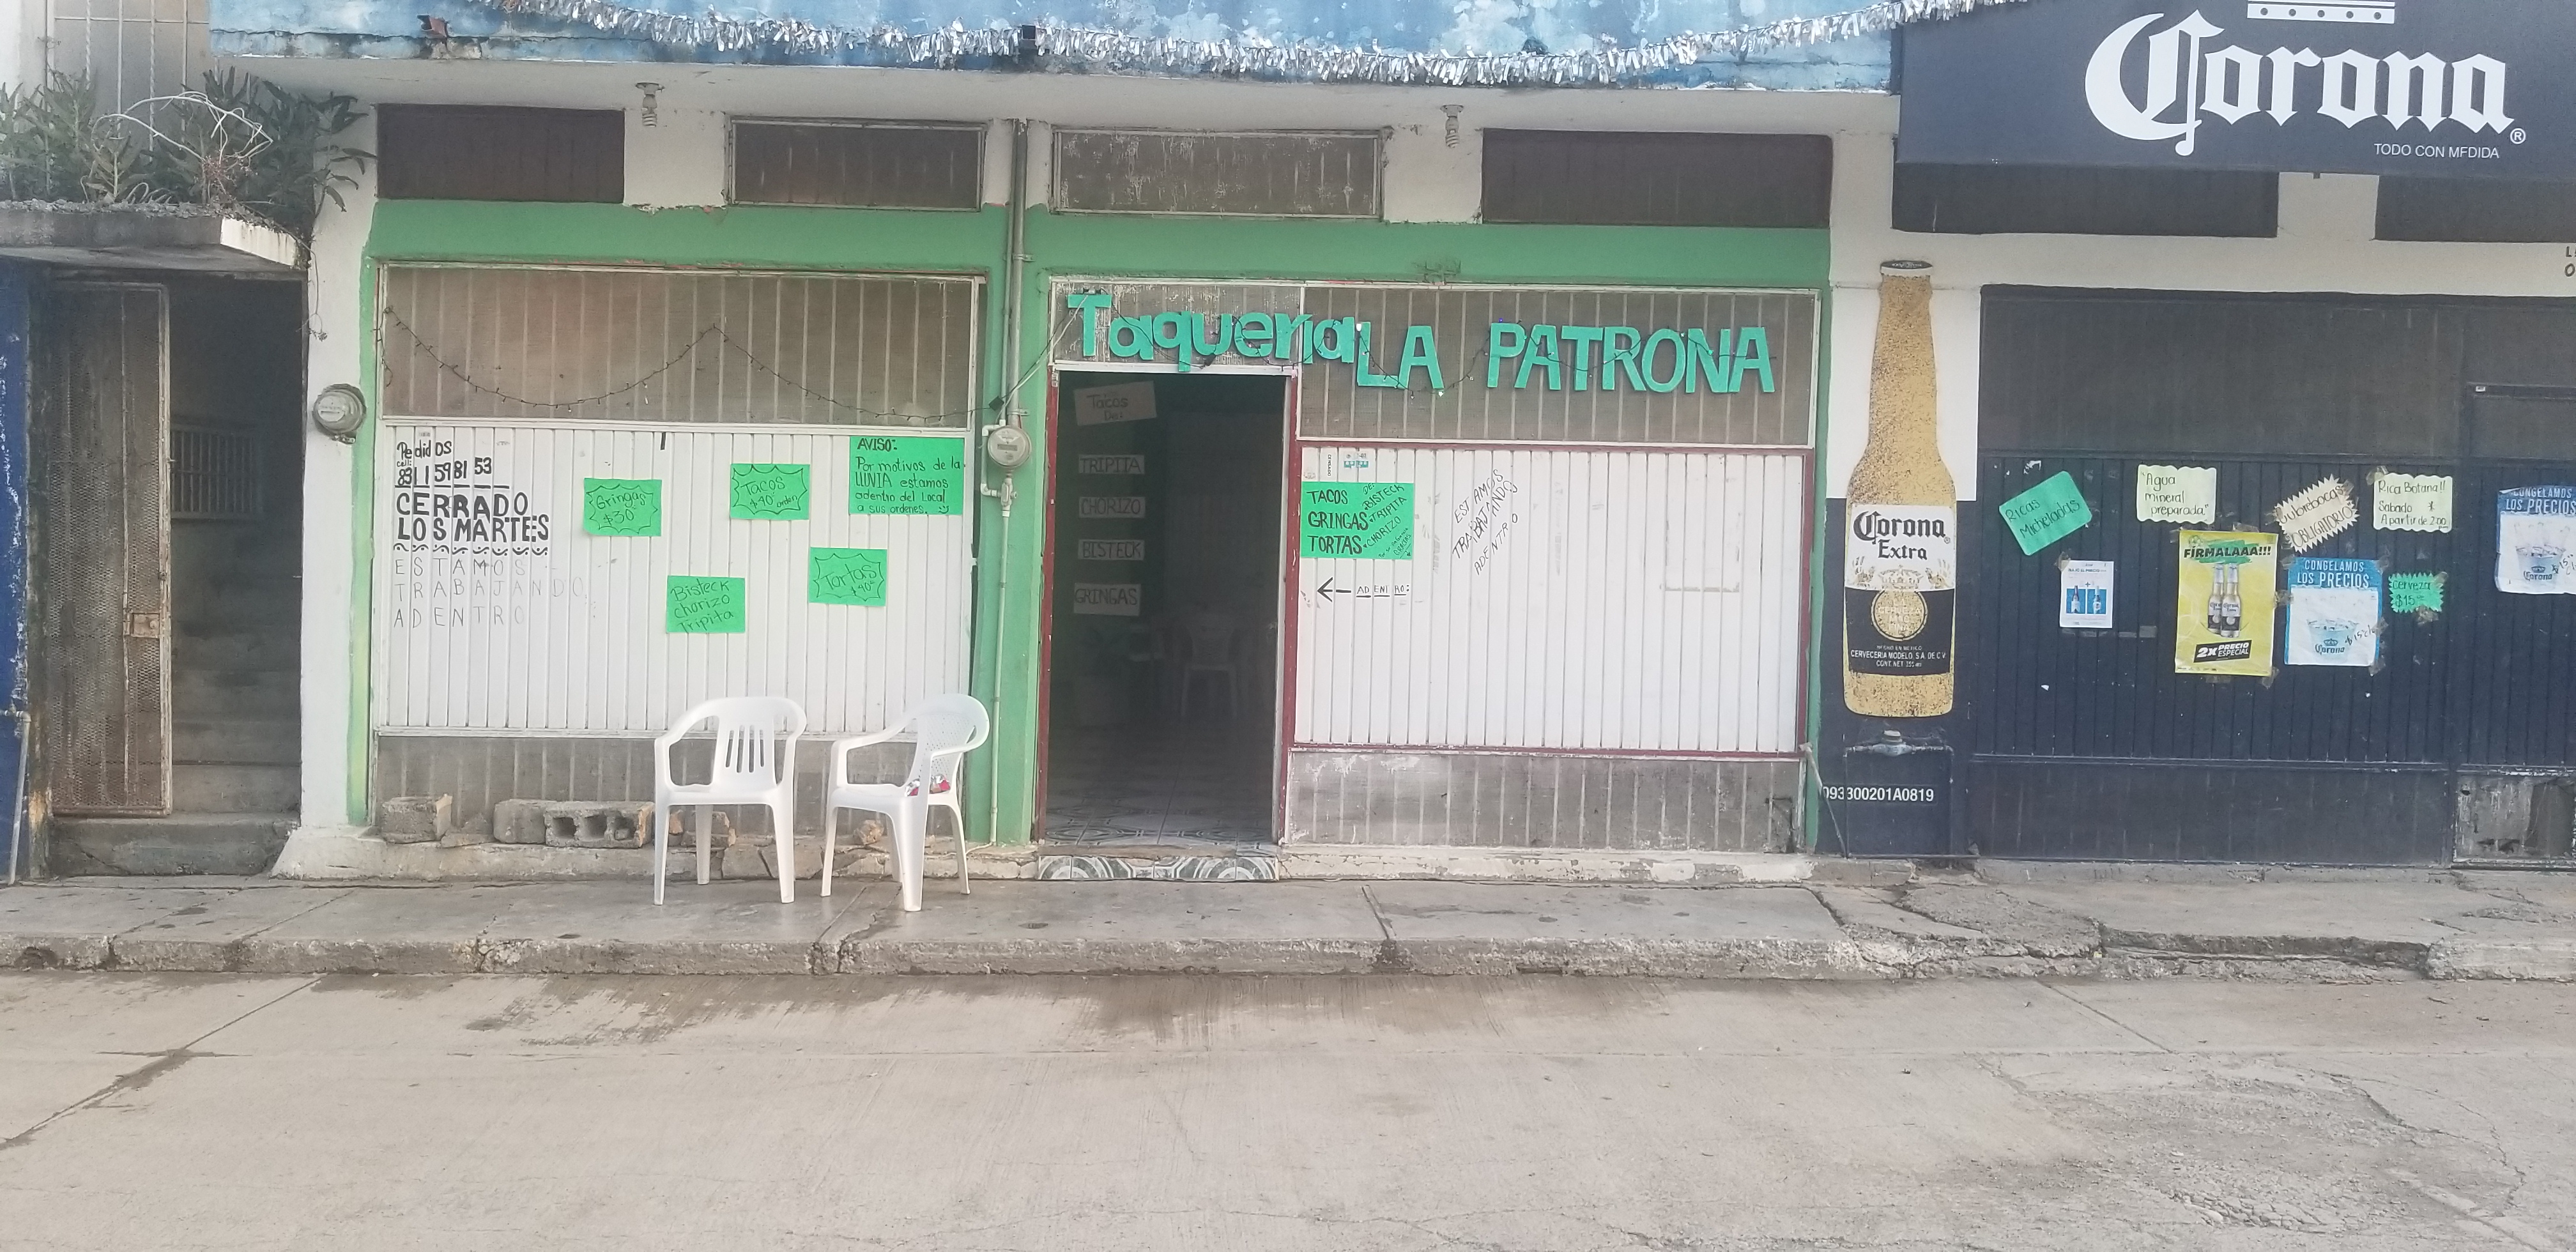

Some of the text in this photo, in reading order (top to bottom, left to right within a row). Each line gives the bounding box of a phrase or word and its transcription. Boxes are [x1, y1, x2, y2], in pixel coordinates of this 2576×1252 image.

[2085, 9, 2515, 156] Corona
[2374, 143, 2411, 156] TODO
[2415, 145, 2445, 158] CON
[1068, 294, 1355, 372] Taqueria
[1358, 321, 1775, 393] LA PATRONA
[857, 438, 898, 452] AVISO:
[855, 455, 960, 472] Por motivos de la
[1079, 457, 1142, 473] TRIPITA
[900, 472, 949, 489] estamos
[2378, 480, 2401, 494] Rica
[596, 492, 646, 510] Gringas
[855, 489, 896, 501] adentro
[900, 490, 915, 502] del
[1307, 489, 1349, 505] TACOS
[1363, 484, 1405, 508] BISTECK
[1454, 469, 1503, 524] ESTAMOS
[2145, 490, 2184, 503] mineral
[2276, 485, 2343, 524] Cubrebocas
[396, 492, 529, 522] CERRADO
[869, 505, 885, 514] sus
[1081, 498, 1141, 515] CHORIZO
[1368, 496, 1407, 522] TRIPITA
[2379, 500, 2412, 513] Sabado
[2506, 498, 2576, 514] LOS PRECIOS
[1308, 511, 1369, 531] GRINGAS
[1853, 510, 1946, 545] Corona
[2020, 500, 2081, 538] Micheladas
[2418, 515, 2427, 525] de
[397, 517, 447, 542] LOS
[1367, 515, 1402, 547] CHORIZO
[1082, 541, 1141, 558] BISTECK
[1307, 535, 1363, 555] TORTAS
[1474, 513, 1518, 576] ADENTRO
[1878, 538, 1928, 560] Extra
[395, 556, 526, 577] ESTAMOS
[2304, 560, 2365, 572] CONGELAMOS
[820, 563, 877, 590] Tortas
[2297, 572, 2370, 588] LOS PRECIOS
[2523, 570, 2553, 581] Corona
[394, 576, 583, 602] TRABAJANDO
[1075, 588, 1137, 606] GRINGAS
[394, 605, 525, 629] ADENTRO
[677, 610, 734, 634] Tripita
[1850, 650, 1887, 659] CERVECERIA
[2218, 642, 2250, 651] PRECIO
[2218, 648, 2249, 657] ESPECIAL
[2315, 643, 2345, 655] Corona
